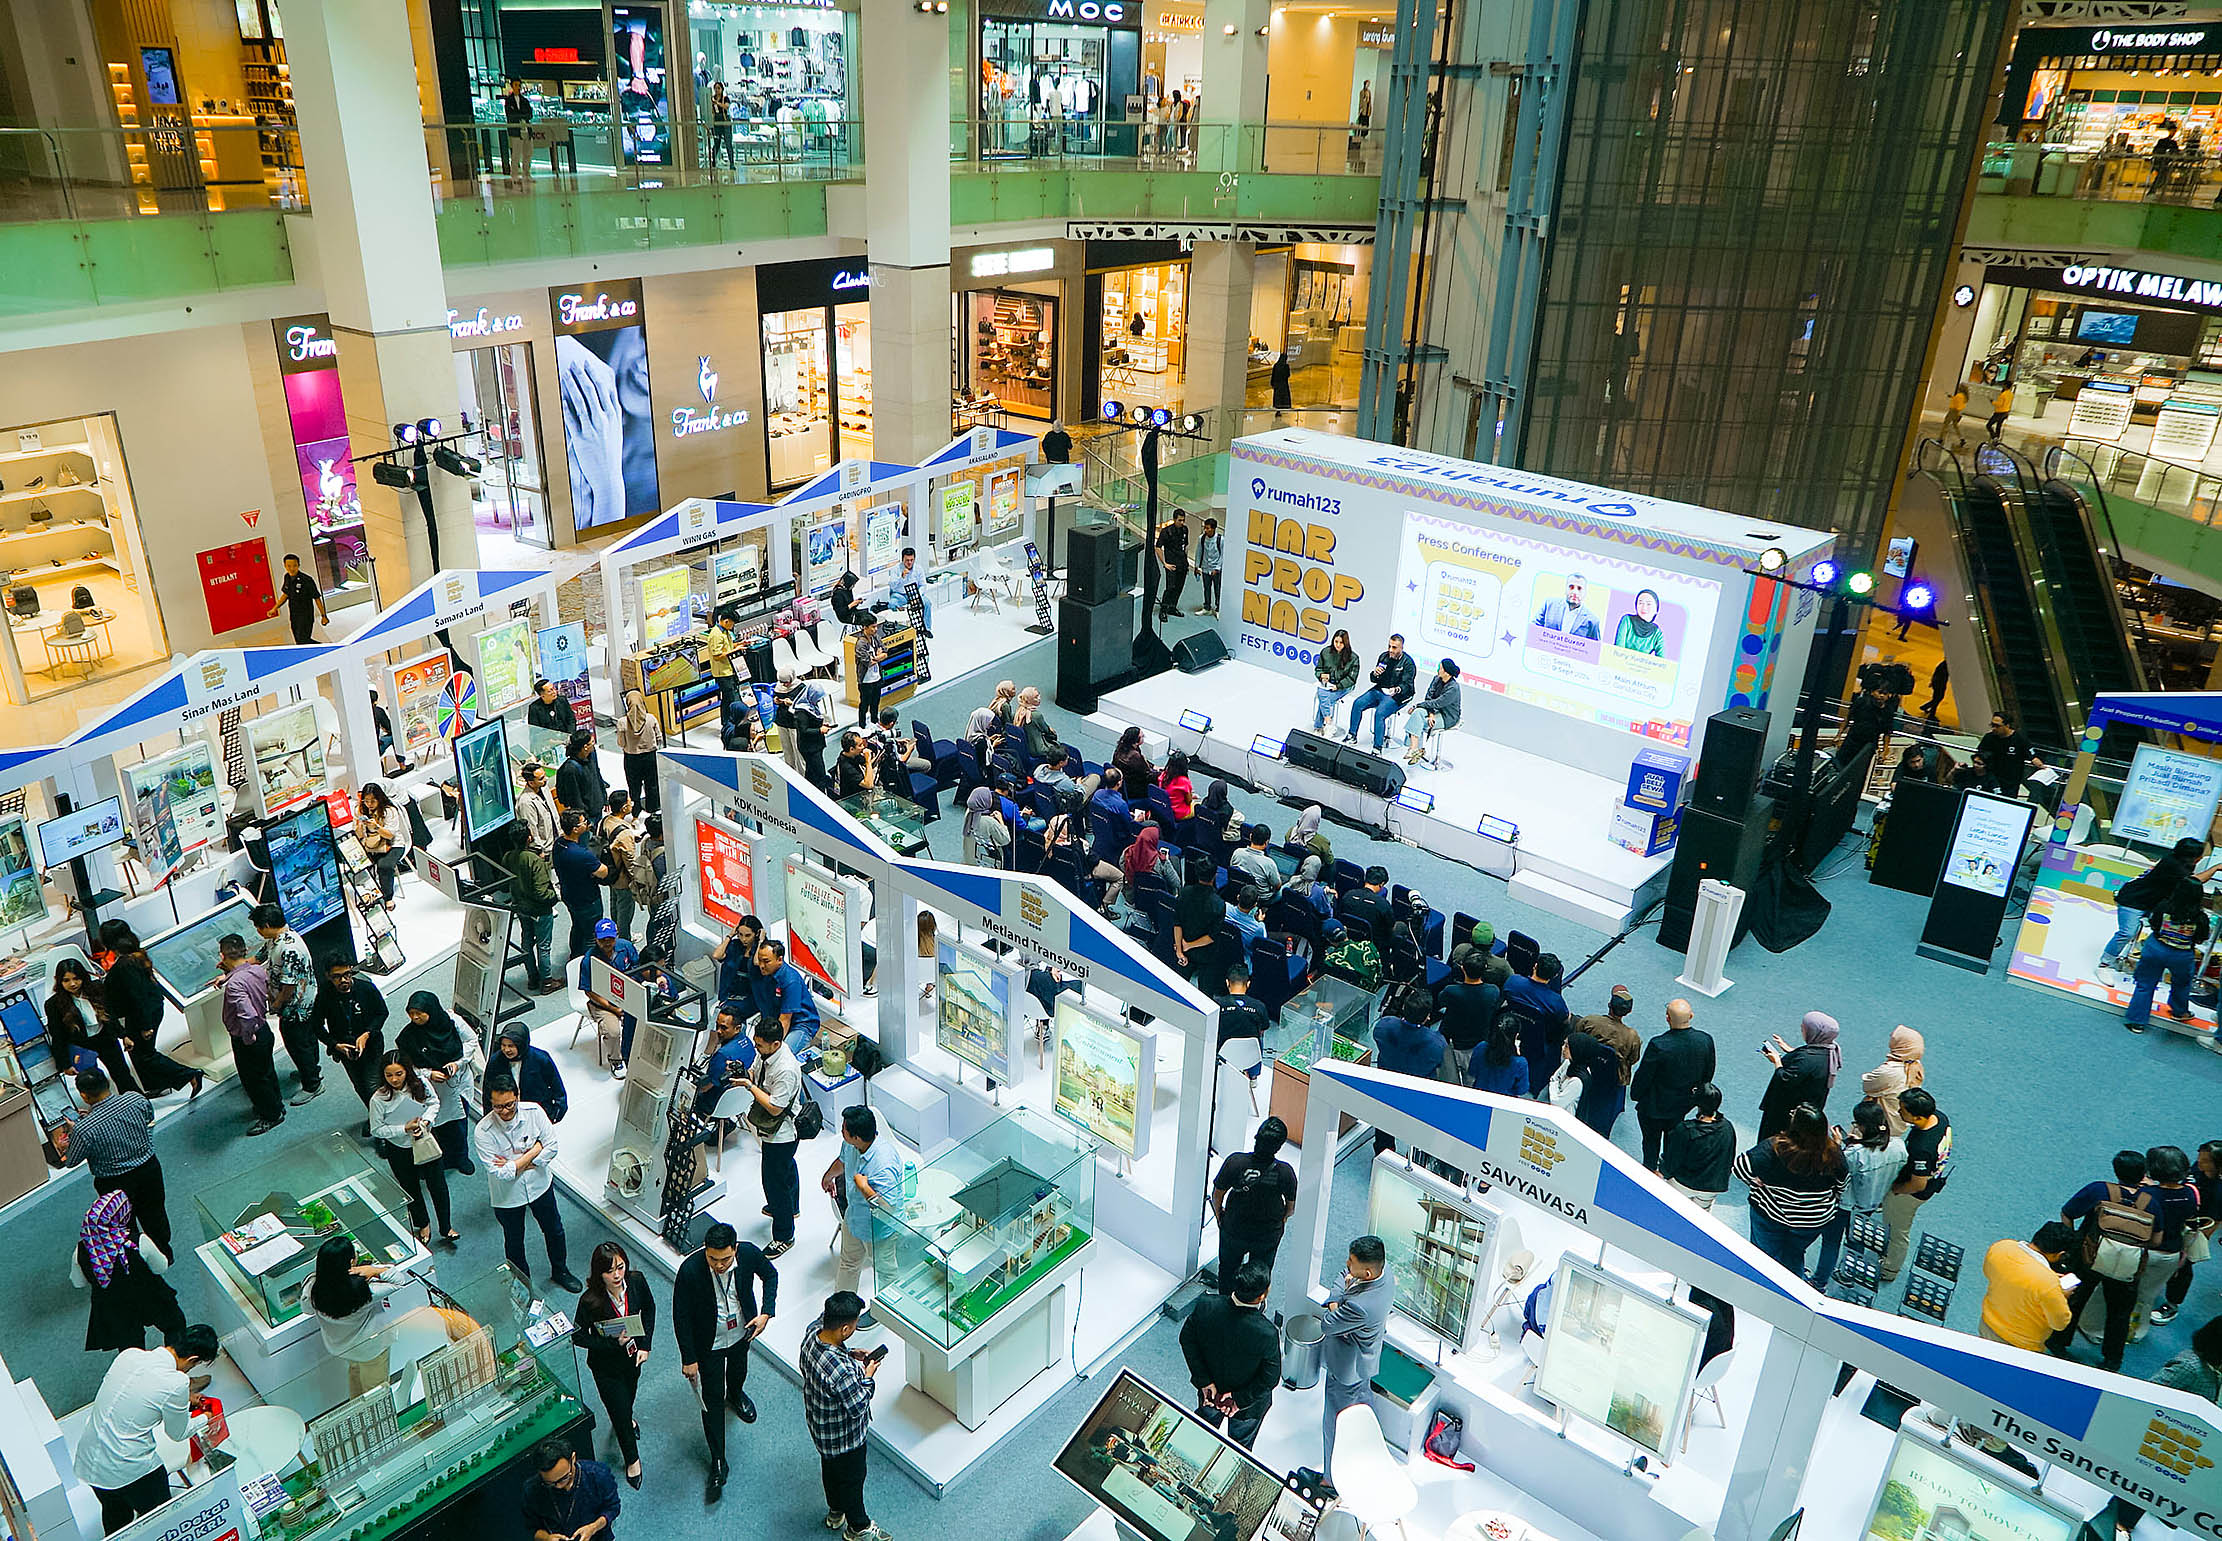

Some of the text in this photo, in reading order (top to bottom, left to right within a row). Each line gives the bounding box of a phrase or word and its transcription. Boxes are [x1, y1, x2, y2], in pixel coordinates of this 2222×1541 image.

[1048, 0, 1124, 22] MOC
[2111, 31, 2205, 47] THE BODY SHOP
[2062, 264, 2222, 307] OPTIK MELAW
[558, 293, 609, 326] Frank
[672, 405, 720, 438] Frank
[838, 486, 872, 501] GADINGPRO
[1367, 456, 1590, 505] rumah123
[1267, 487, 1342, 515] rumah123
[682, 530, 717, 546] WINN GAS
[1247, 508, 1337, 566] HAR
[1418, 532, 1522, 568] Press Conference
[210, 572, 238, 587] HYDRANT
[1244, 548, 1365, 611] PROP
[434, 602, 485, 628] Samara Land
[1242, 589, 1331, 645] NAS
[1240, 633, 1322, 668] FEST. 202
[182, 684, 260, 722] Sinar Mas Land
[1641, 783, 1665, 793] SEWA
[1645, 772, 1665, 782] JUAL
[1645, 779, 1663, 788] BELI
[734, 795, 798, 835] KDK Indonesia
[718, 842, 737, 861] WITH
[738, 851, 751, 868] AIR
[800, 888, 820, 905] FUTURE
[820, 899, 834, 912] WITH
[804, 881, 845, 908] VITALIZE THE
[982, 915, 1090, 978] Metland Transyogi
[1523, 1125, 1557, 1150] HAR
[1531, 1121, 1559, 1137] rumah123
[1519, 1147, 1555, 1171] NAS
[1521, 1136, 1566, 1164] PROP
[1480, 1160, 1588, 1225] SAVYAVASA
[2147, 1418, 2203, 1453] HAR
[2164, 1414, 2209, 1438] rumah123
[1991, 1409, 2038, 1445] The
[2042, 1437, 2188, 1518] Sanctuary
[2138, 1443, 2194, 1477] NAS
[2143, 1430, 2215, 1470] PROP
[1908, 1470, 1954, 1499] READY
[1959, 1497, 1978, 1512] TO
[1982, 1508, 2025, 1537] MOVE
[194, 1515, 227, 1540] KRL
